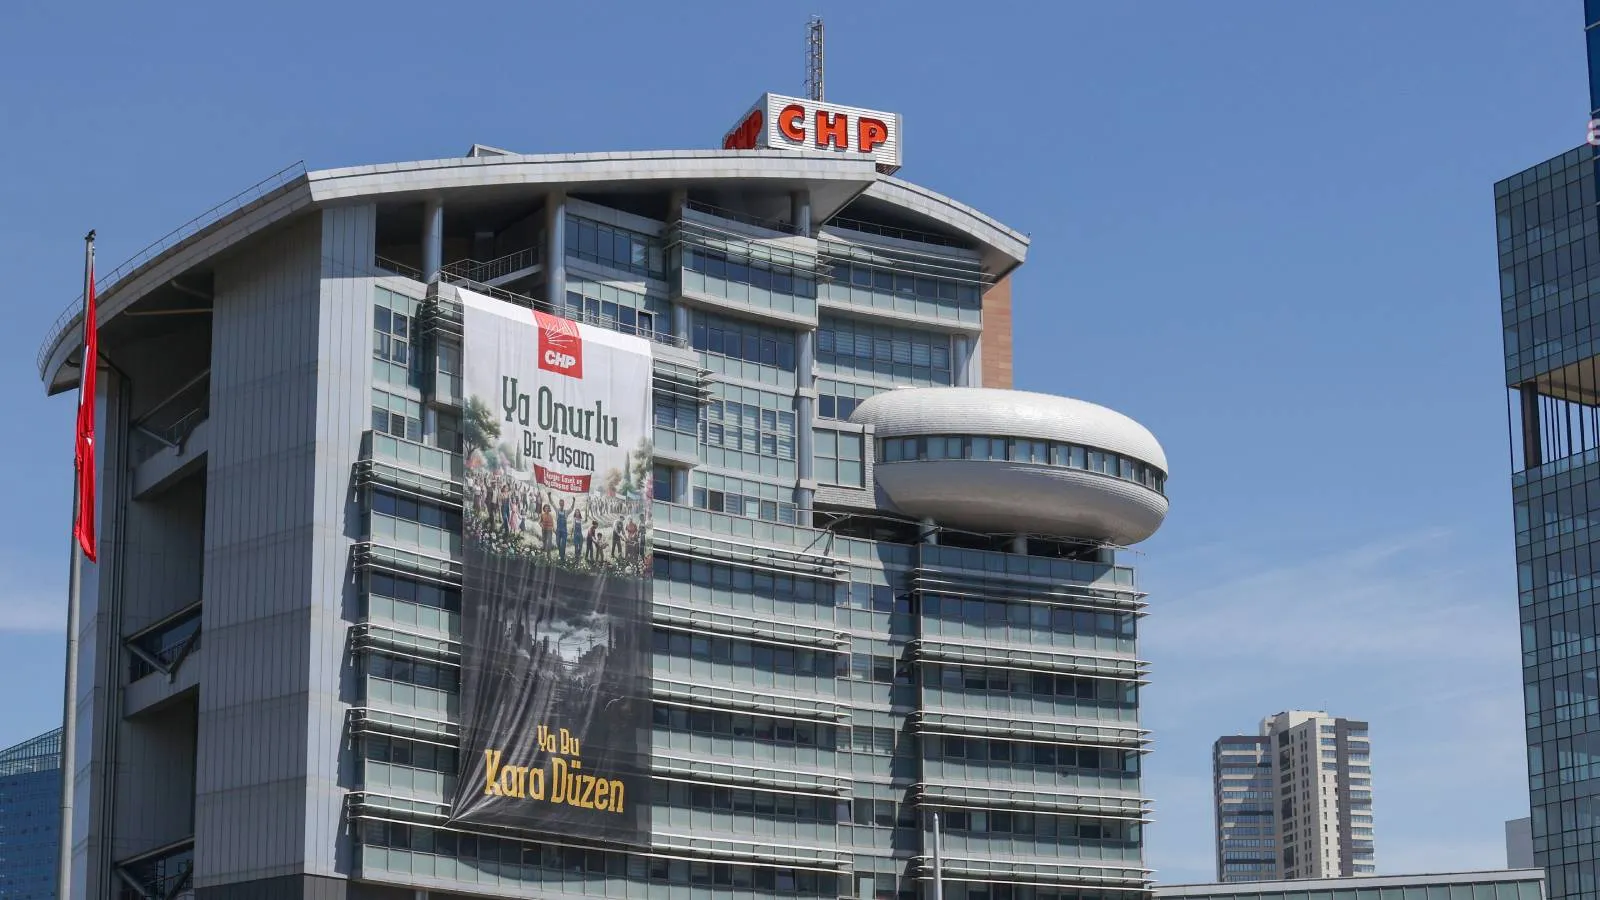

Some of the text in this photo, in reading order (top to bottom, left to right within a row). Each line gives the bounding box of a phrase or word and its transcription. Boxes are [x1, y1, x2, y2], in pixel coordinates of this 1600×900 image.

[778, 104, 889, 153] CHP
[544, 349, 577, 369] CHP
[502, 375, 619, 447] Ya Onurlu
[523, 429, 595, 472] Bir Yaşam
[537, 725, 580, 757] Ya Bu
[484, 749, 625, 813] Kara Düzen
